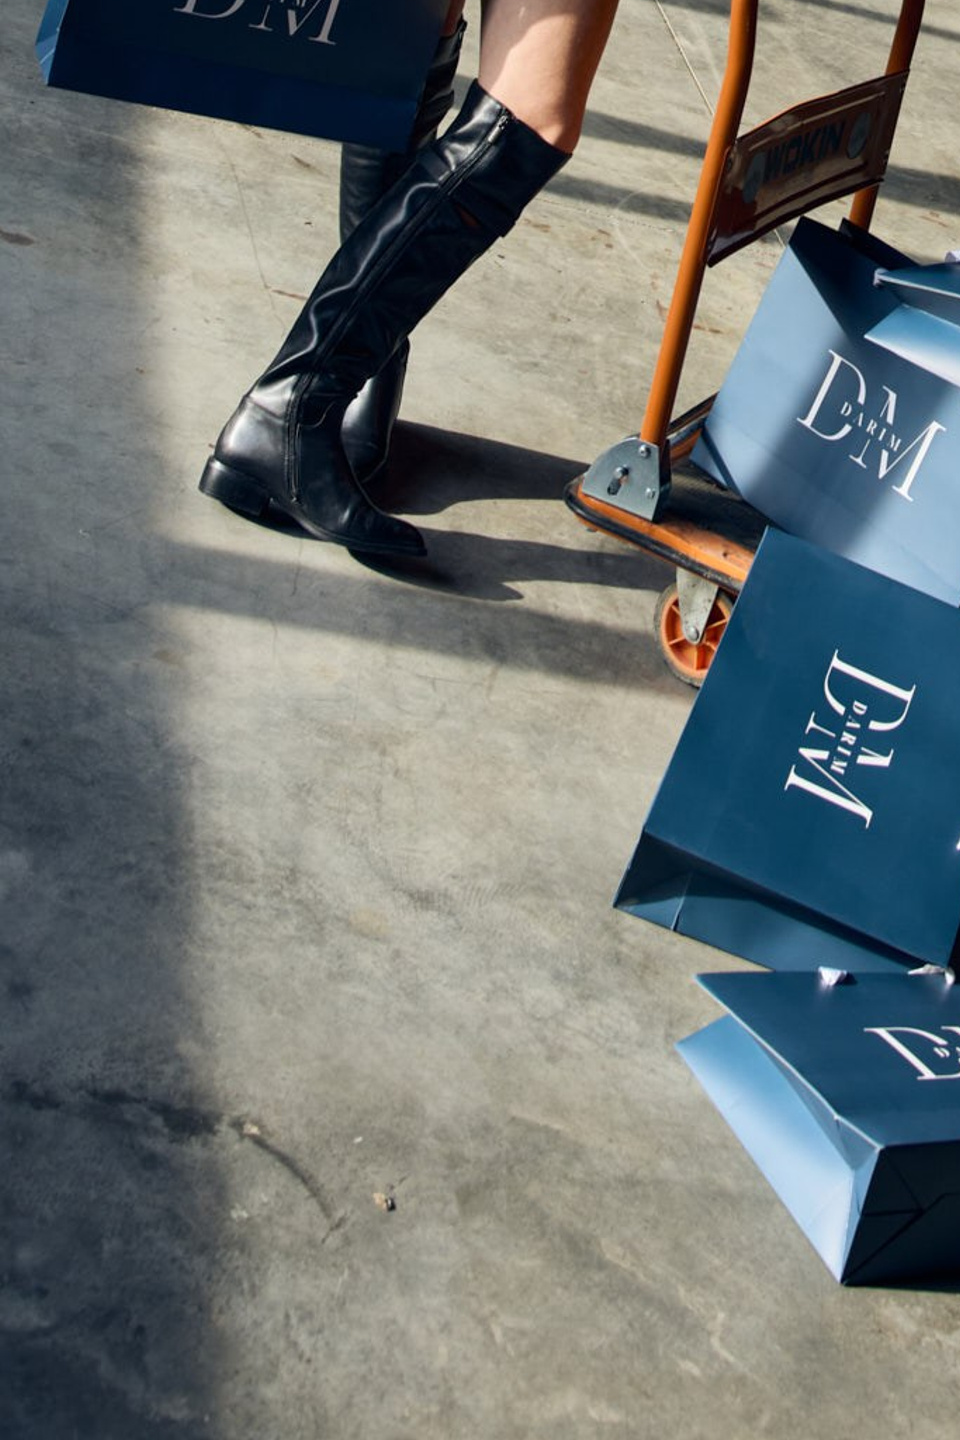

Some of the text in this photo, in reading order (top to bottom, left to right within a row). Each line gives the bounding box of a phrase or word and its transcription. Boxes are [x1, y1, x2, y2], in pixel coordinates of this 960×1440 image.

[796, 349, 947, 503] DM
[840, 401, 902, 452] DARIM
[784, 649, 917, 830] DM
[829, 699, 868, 776] DARIM
